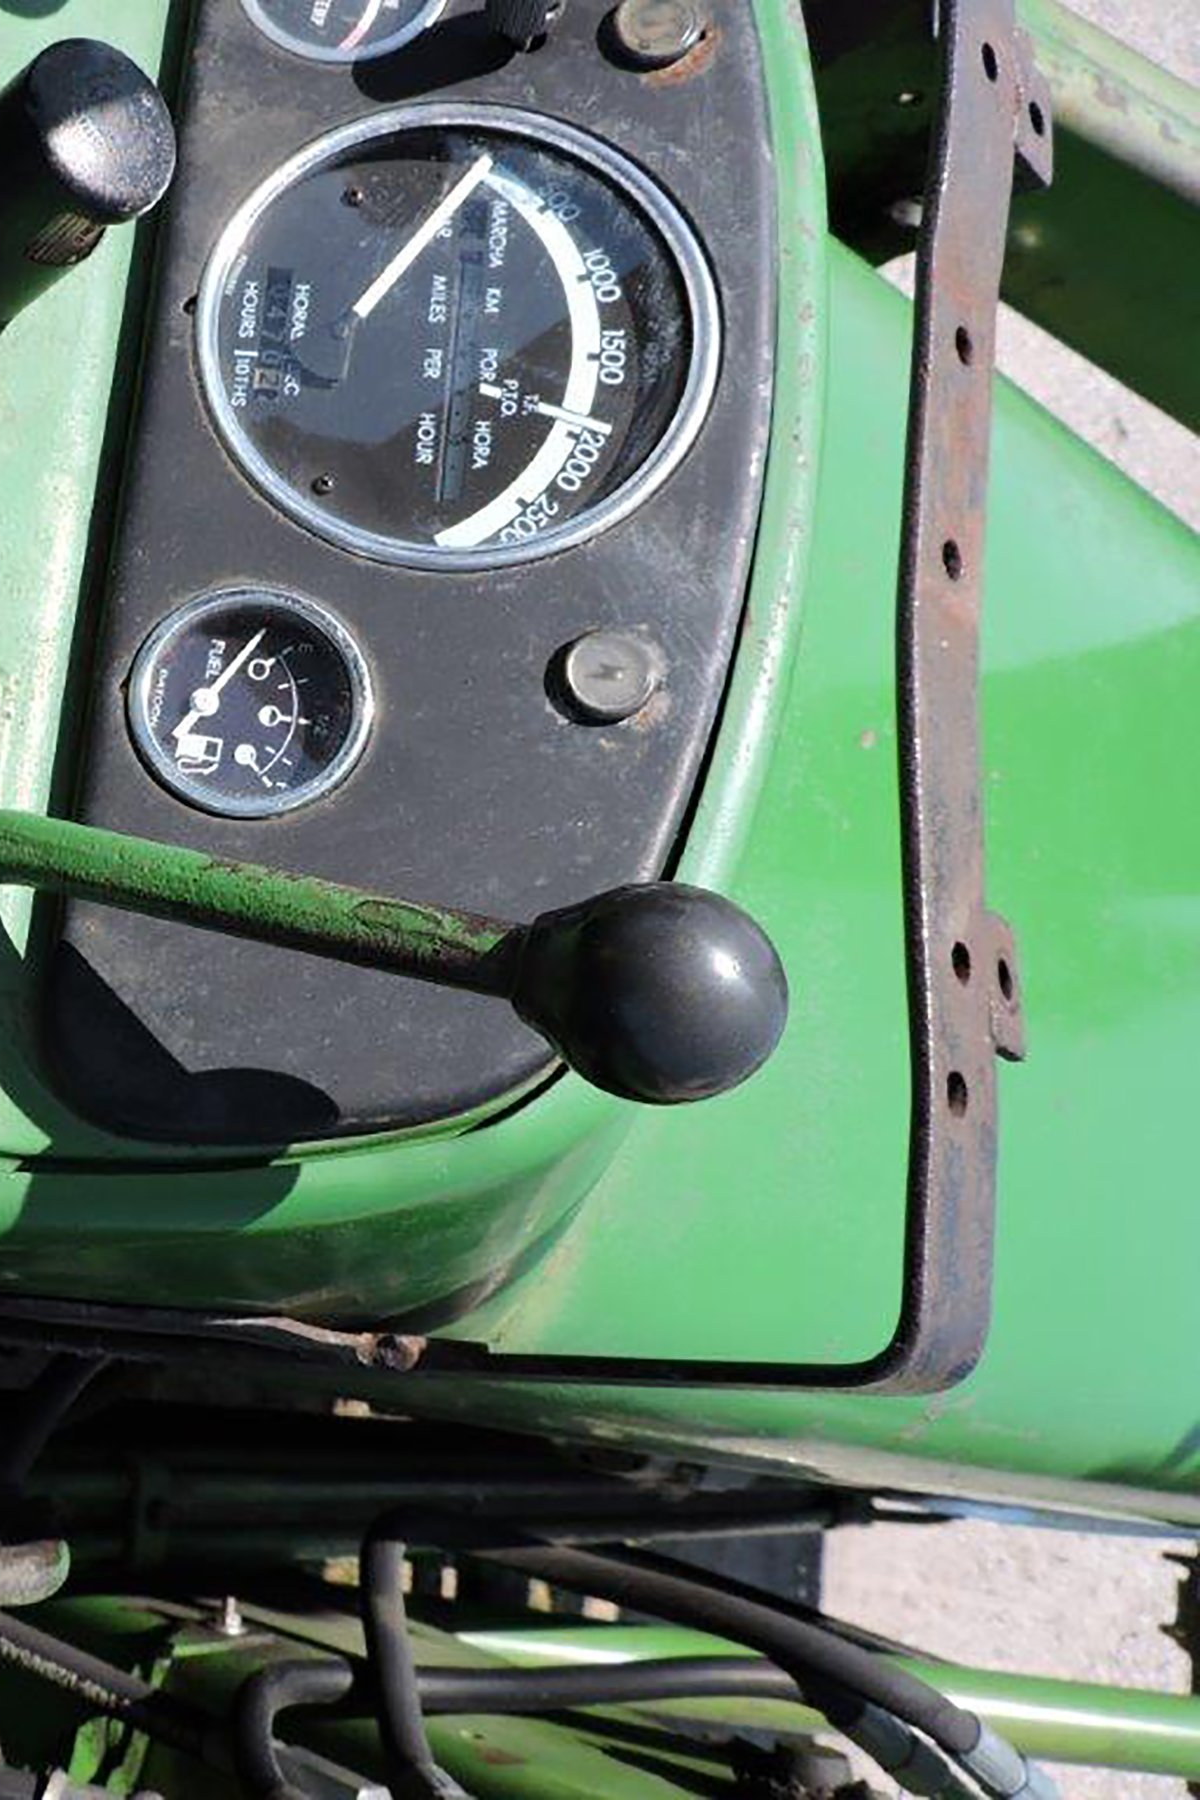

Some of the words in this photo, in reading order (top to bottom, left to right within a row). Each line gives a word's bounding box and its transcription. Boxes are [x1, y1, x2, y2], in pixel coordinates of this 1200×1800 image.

[488, 200, 510, 268] MARCHA
[428, 274, 449, 323] MILES
[484, 287, 501, 314] KM
[583, 248, 622, 304] 1000
[238, 281, 259, 338] HOURS
[422, 348, 443, 380] PER
[479, 348, 498, 382] POR
[600, 329, 626, 385] 1500
[415, 412, 436, 465] HOUR
[471, 420, 491, 470] HORA
[556, 430, 606, 492] 2000
[500, 494, 559, 543] 2500
[205, 638, 226, 679] FUEL
